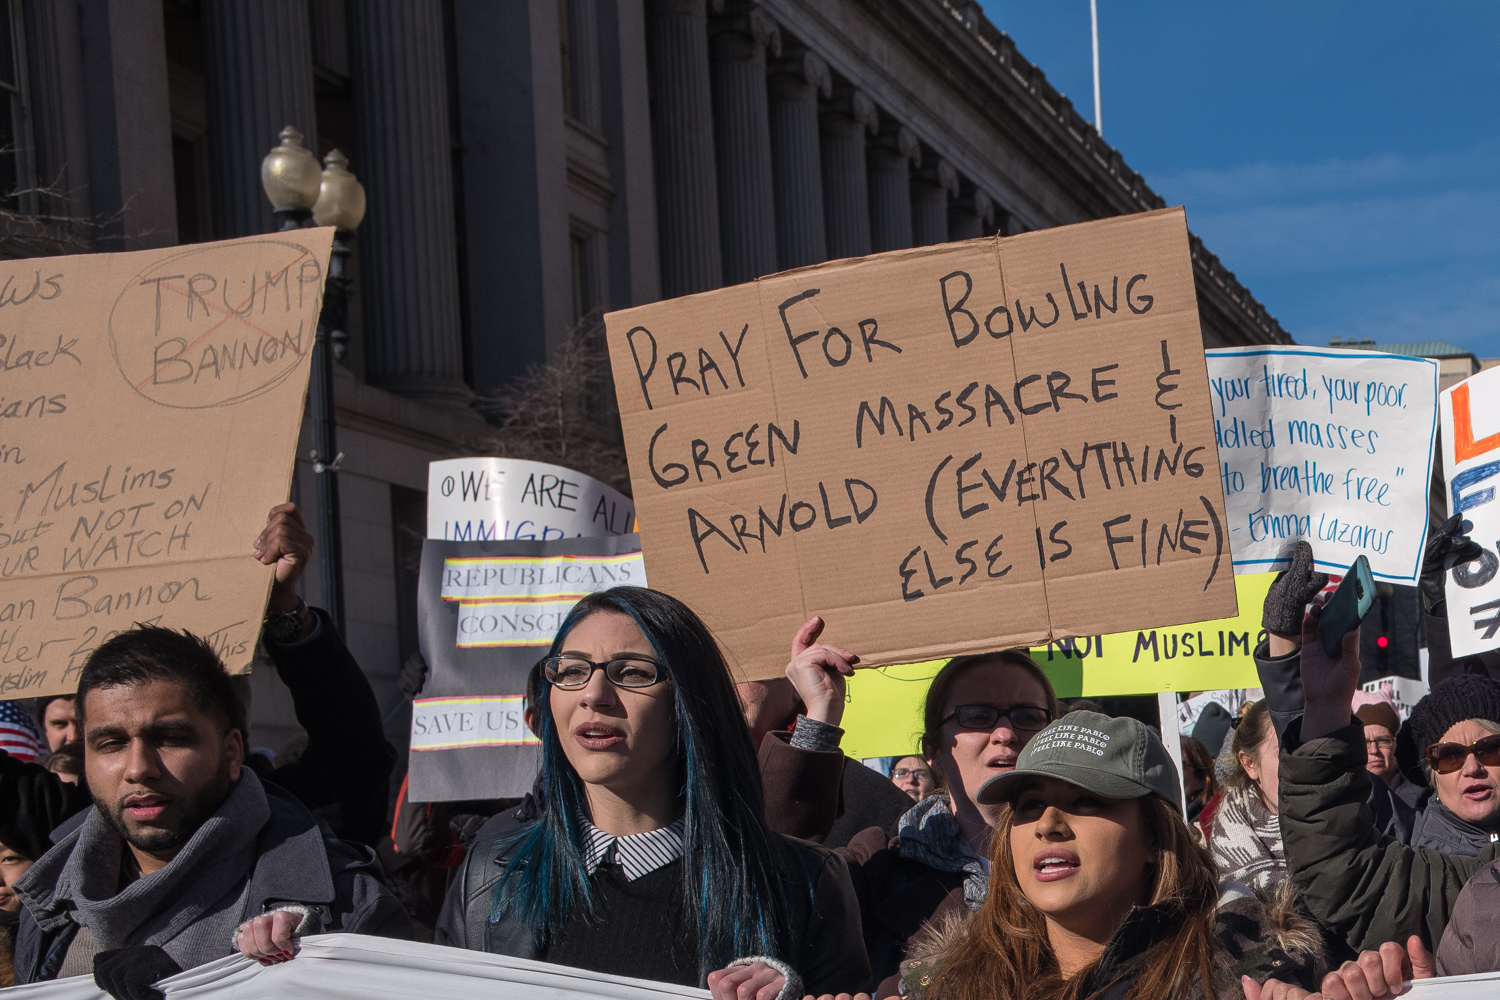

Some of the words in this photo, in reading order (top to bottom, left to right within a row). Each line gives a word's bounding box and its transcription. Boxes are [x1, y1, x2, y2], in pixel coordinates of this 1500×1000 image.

[140, 260, 321, 337] TRUMP
[153, 320, 304, 385] BANNON
[626, 323, 749, 410] PRAY
[778, 288, 902, 378] FOR
[1211, 376, 1252, 417] your
[1321, 375, 1360, 415] your
[648, 419, 801, 490] GREEN
[854, 363, 1120, 449] MASSACRE
[1288, 420, 1379, 455] masses
[521, 473, 579, 512] ARE
[1221, 462, 1245, 496] to
[1261, 460, 1335, 497] breathe
[70, 502, 155, 542] NOT
[164, 482, 212, 519] ON
[687, 476, 879, 575] ARNOLD
[924, 441, 1206, 543] (EVERYTHING
[62, 522, 193, 572] WATCH
[899, 533, 1014, 603] ELSE
[1036, 519, 1075, 571] IS
[1104, 495, 1224, 592] FINE)
[446, 562, 632, 588] REPUBLICANS
[53, 575, 212, 620] Bannon
[460, 611, 562, 636] CONSCI
[413, 711, 474, 735] SAVE
[486, 710, 519, 732] US
[1054, 732, 1076, 740] LIKE
[1077, 734, 1107, 748] PABLO
[1080, 727, 1110, 740] PABLO
[1051, 740, 1073, 748] LIKE
[1074, 742, 1104, 757] PABLO
